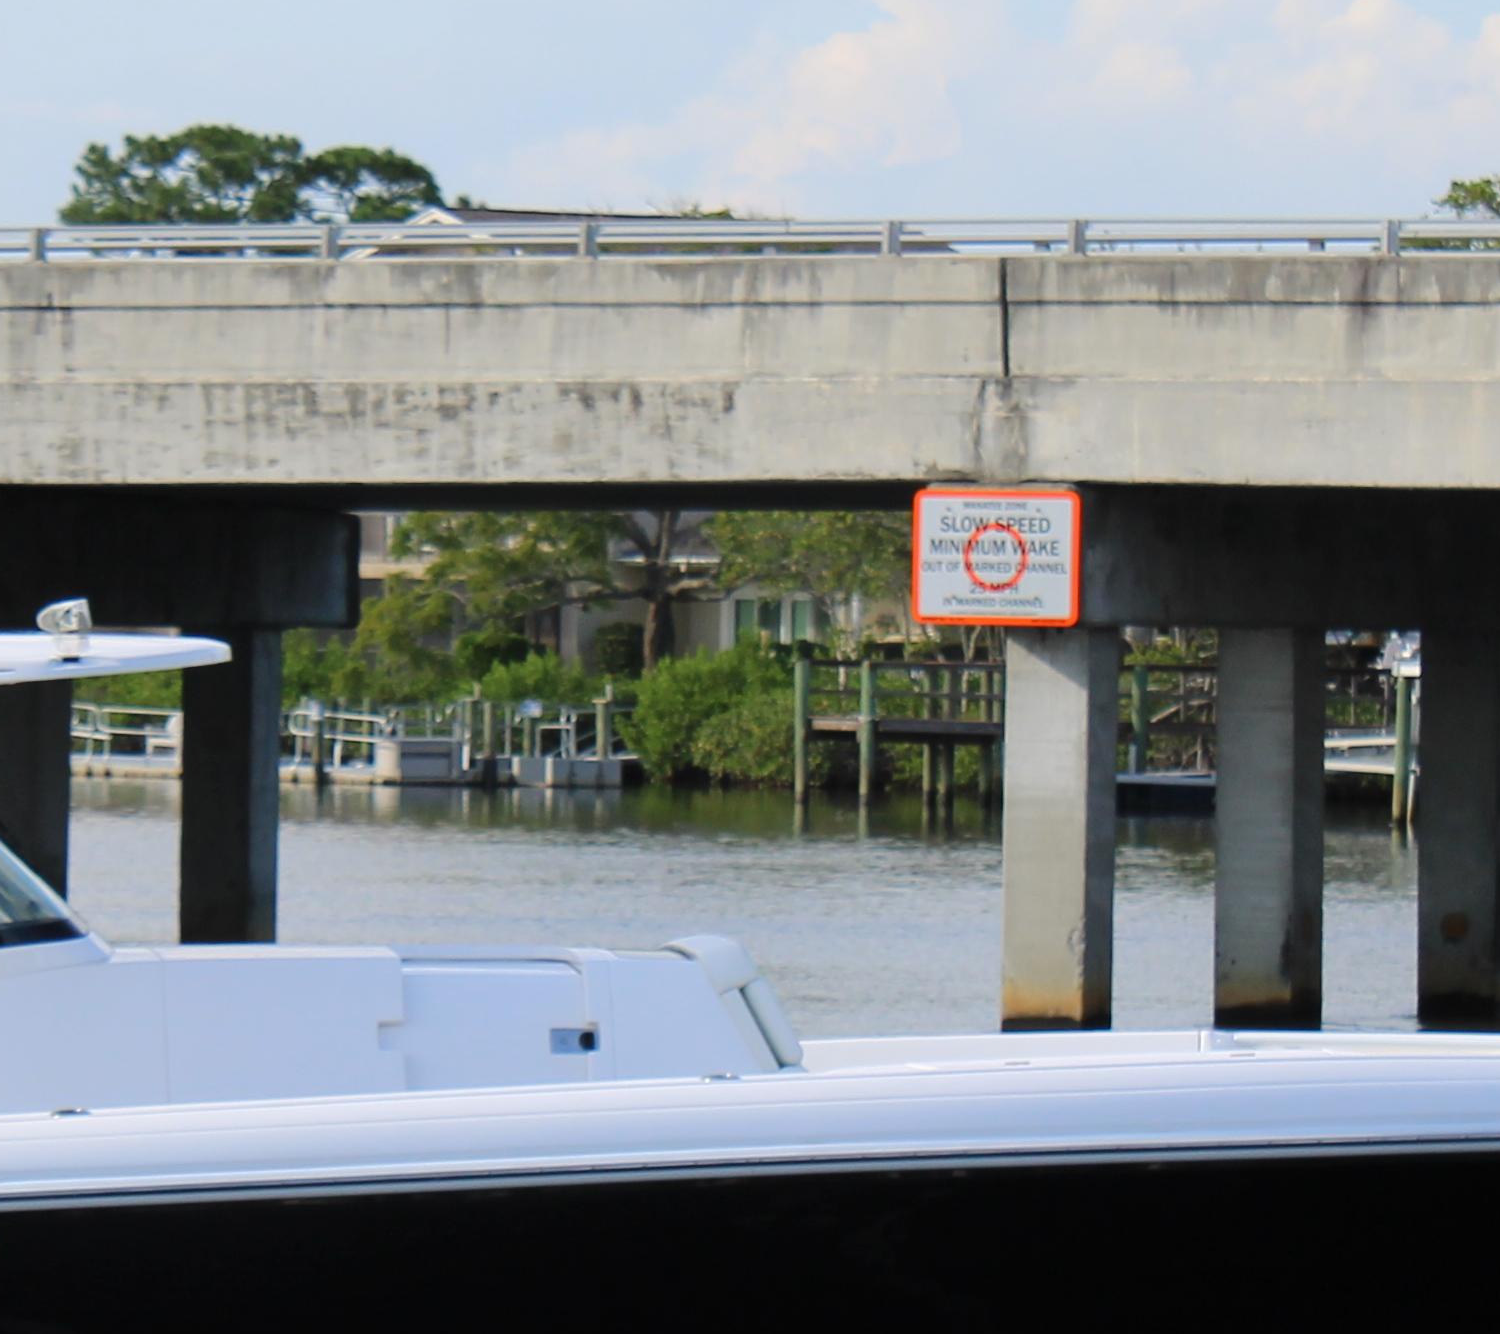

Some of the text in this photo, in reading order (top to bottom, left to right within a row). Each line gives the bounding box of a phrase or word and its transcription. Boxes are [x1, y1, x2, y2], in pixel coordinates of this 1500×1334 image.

[939, 516, 1052, 534] SLOW SPEED
[929, 538, 1060, 557] MINIMUM WAKE
[921, 560, 1068, 575] OUT OF MARKED CHANNEL
[989, 582, 1020, 594] MPH
